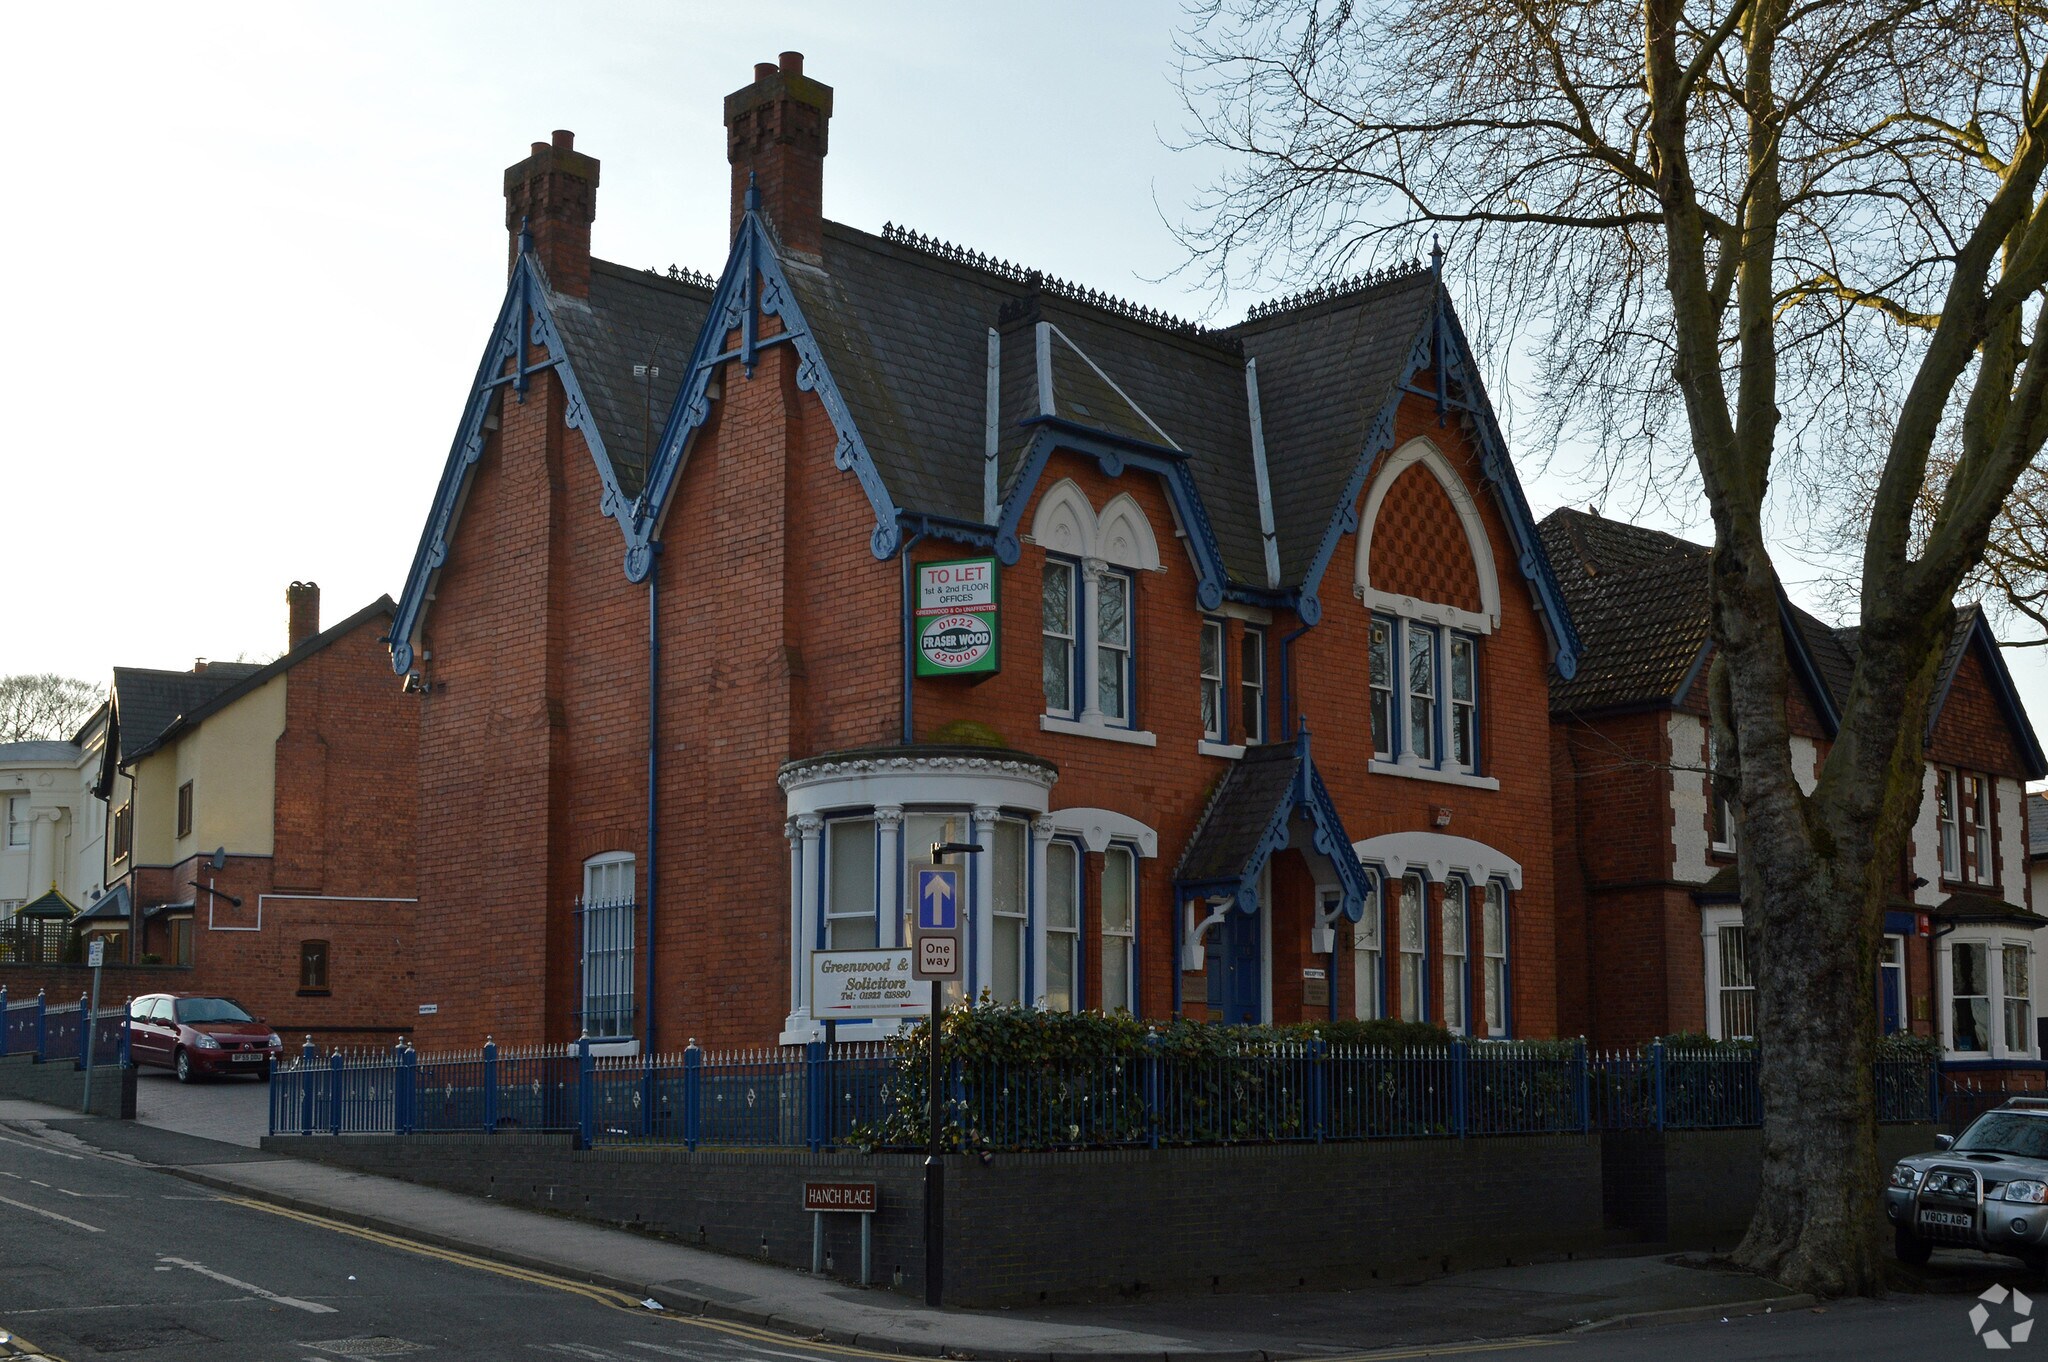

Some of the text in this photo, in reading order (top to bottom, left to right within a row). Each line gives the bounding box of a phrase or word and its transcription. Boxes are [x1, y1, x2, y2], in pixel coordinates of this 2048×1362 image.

[928, 567, 985, 584] TO LET
[945, 585, 959, 593] 2nd
[961, 583, 989, 592] FLOOR
[939, 594, 973, 603] OFFICES
[939, 618, 973, 630] 01922
[923, 633, 990, 648] FRASER WOOD
[934, 648, 978, 662] 629000
[926, 943, 950, 954] One
[821, 958, 908, 973] Greenwood &
[926, 957, 950, 967] way
[845, 977, 906, 991] Solicitors
[840, 992, 856, 1000] Tel:
[859, 991, 881, 1000] 01922
[809, 1188, 871, 1204] HANCH PLACE
